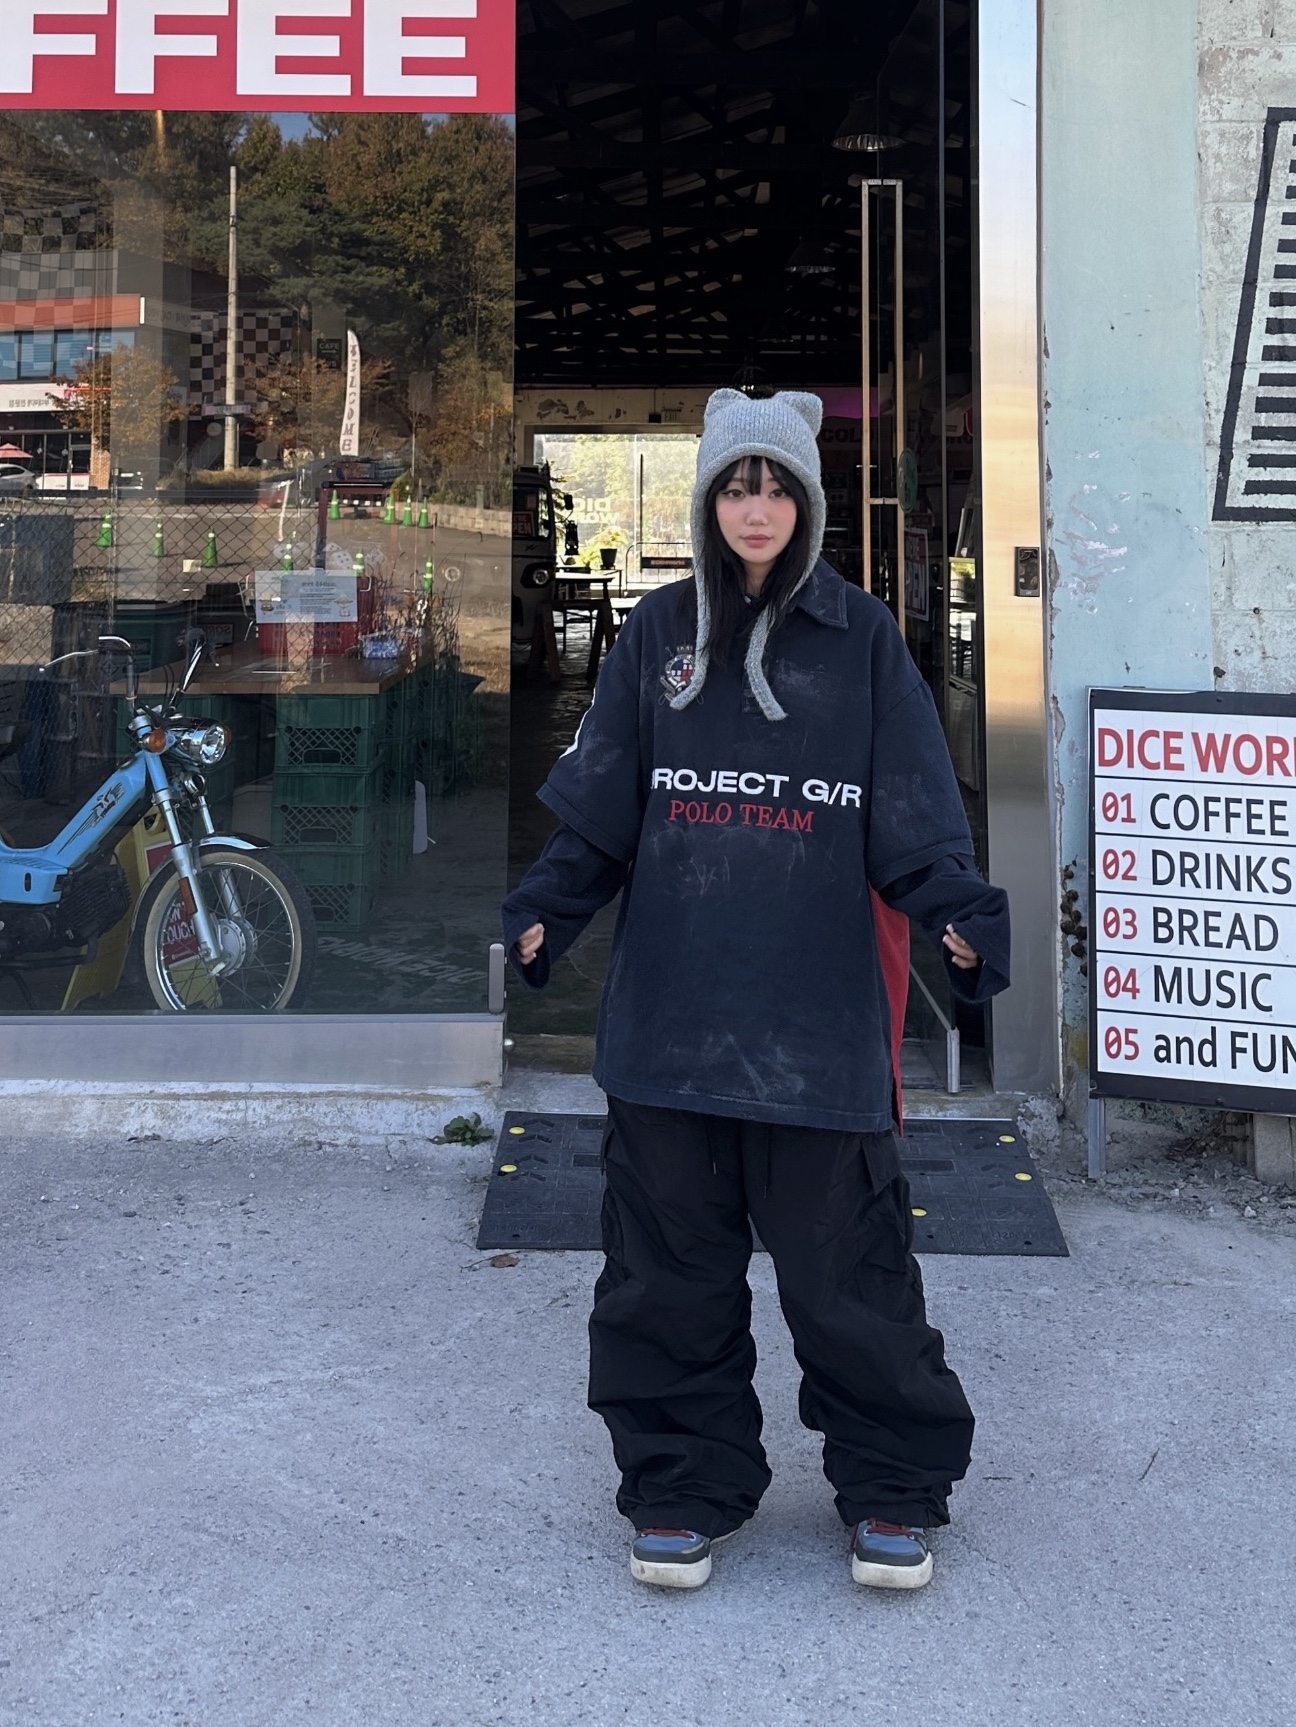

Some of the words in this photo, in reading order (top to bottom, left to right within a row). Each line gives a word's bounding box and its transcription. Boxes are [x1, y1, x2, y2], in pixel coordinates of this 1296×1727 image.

[1098, 727, 1185, 772] DICE
[1191, 731, 1296, 778] WOR
[651, 768, 789, 797] ROJECT
[802, 779, 863, 808] G/R
[669, 800, 732, 824] POLO
[740, 804, 815, 832] TEAM
[1101, 791, 1137, 824] 01
[1150, 792, 1290, 837] COFFEE
[1102, 848, 1138, 882] 02
[1151, 848, 1293, 895] DRINKS
[1103, 906, 1138, 940] 03
[1152, 906, 1279, 952] BREAD
[1104, 966, 1141, 1001] 04
[1153, 964, 1274, 1013] MUSIC
[1104, 1026, 1141, 1061] 05
[1154, 1026, 1218, 1069] and
